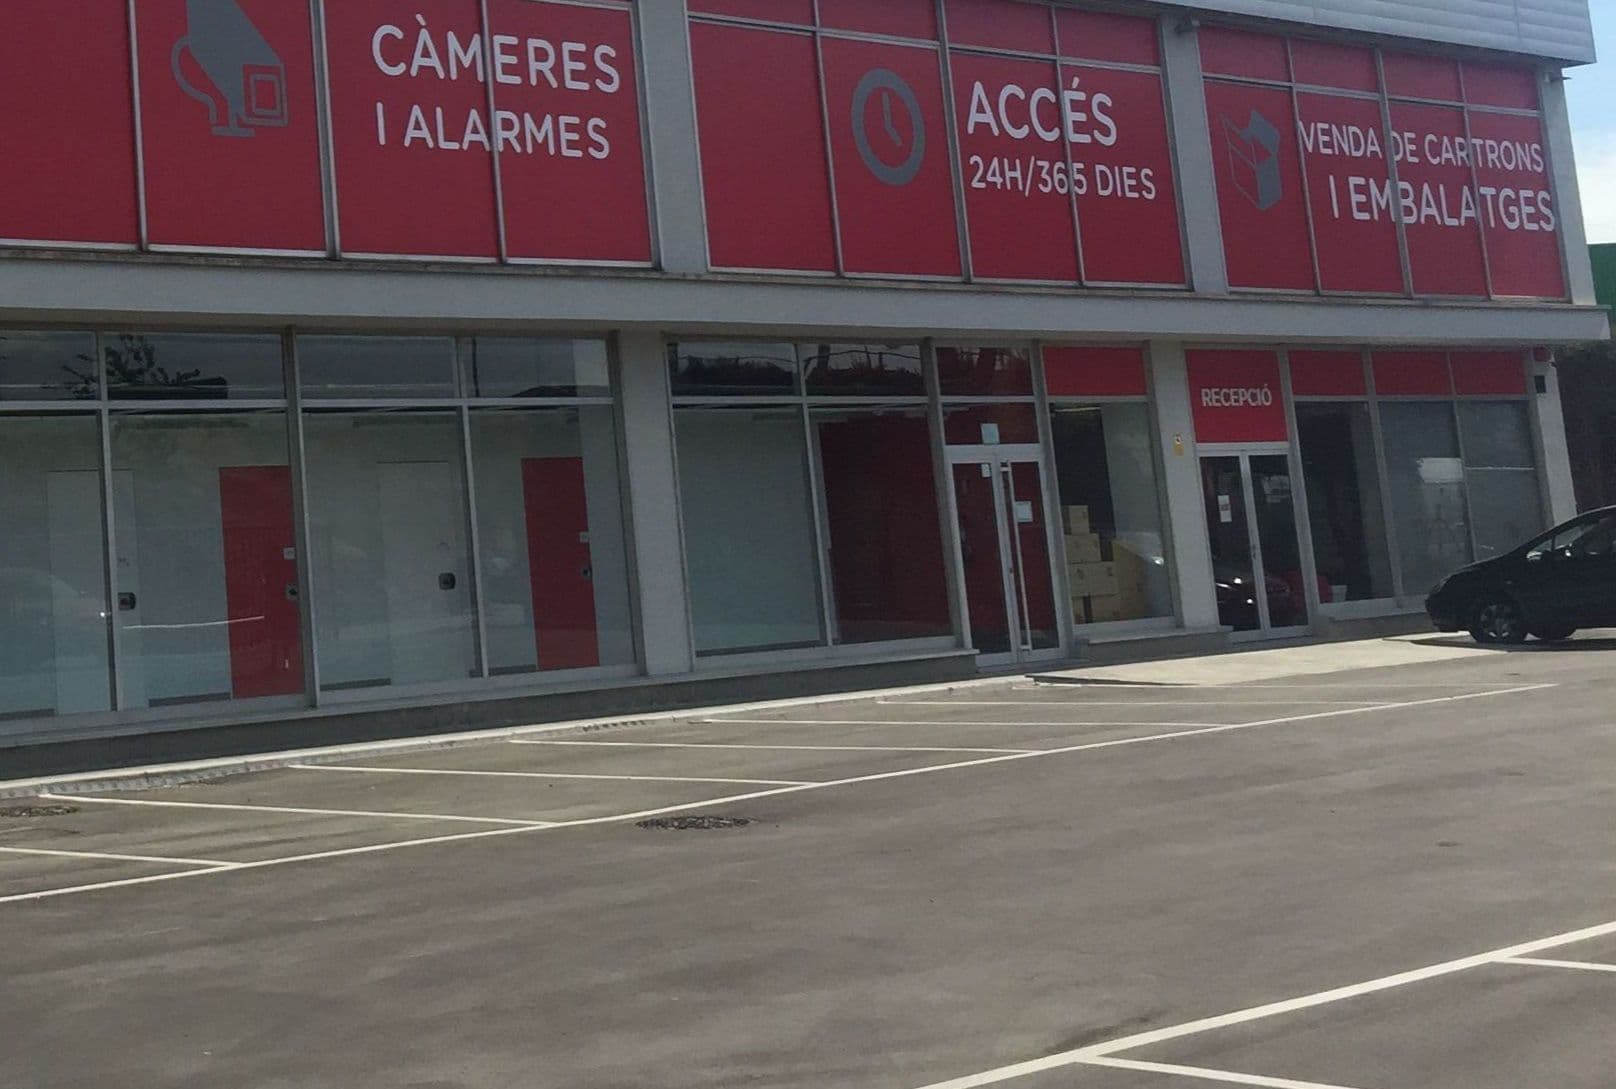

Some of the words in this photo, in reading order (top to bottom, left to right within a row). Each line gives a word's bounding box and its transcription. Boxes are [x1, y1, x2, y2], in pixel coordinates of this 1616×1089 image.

[372, 13, 620, 93] CÀMERES
[376, 102, 386, 146] I
[403, 104, 610, 160] ALARMES
[967, 76, 1117, 146] ACCÉS
[1299, 120, 1383, 159] VENDA
[1390, 129, 1419, 163] DE
[1424, 133, 1545, 173] CARTRONS
[969, 155, 1088, 197] 24H/365
[1095, 164, 1156, 200] DIES
[1329, 174, 1339, 219] I
[1348, 176, 1556, 232] EMBALATGES
[1201, 384, 1272, 407] RECEPCIÓ
